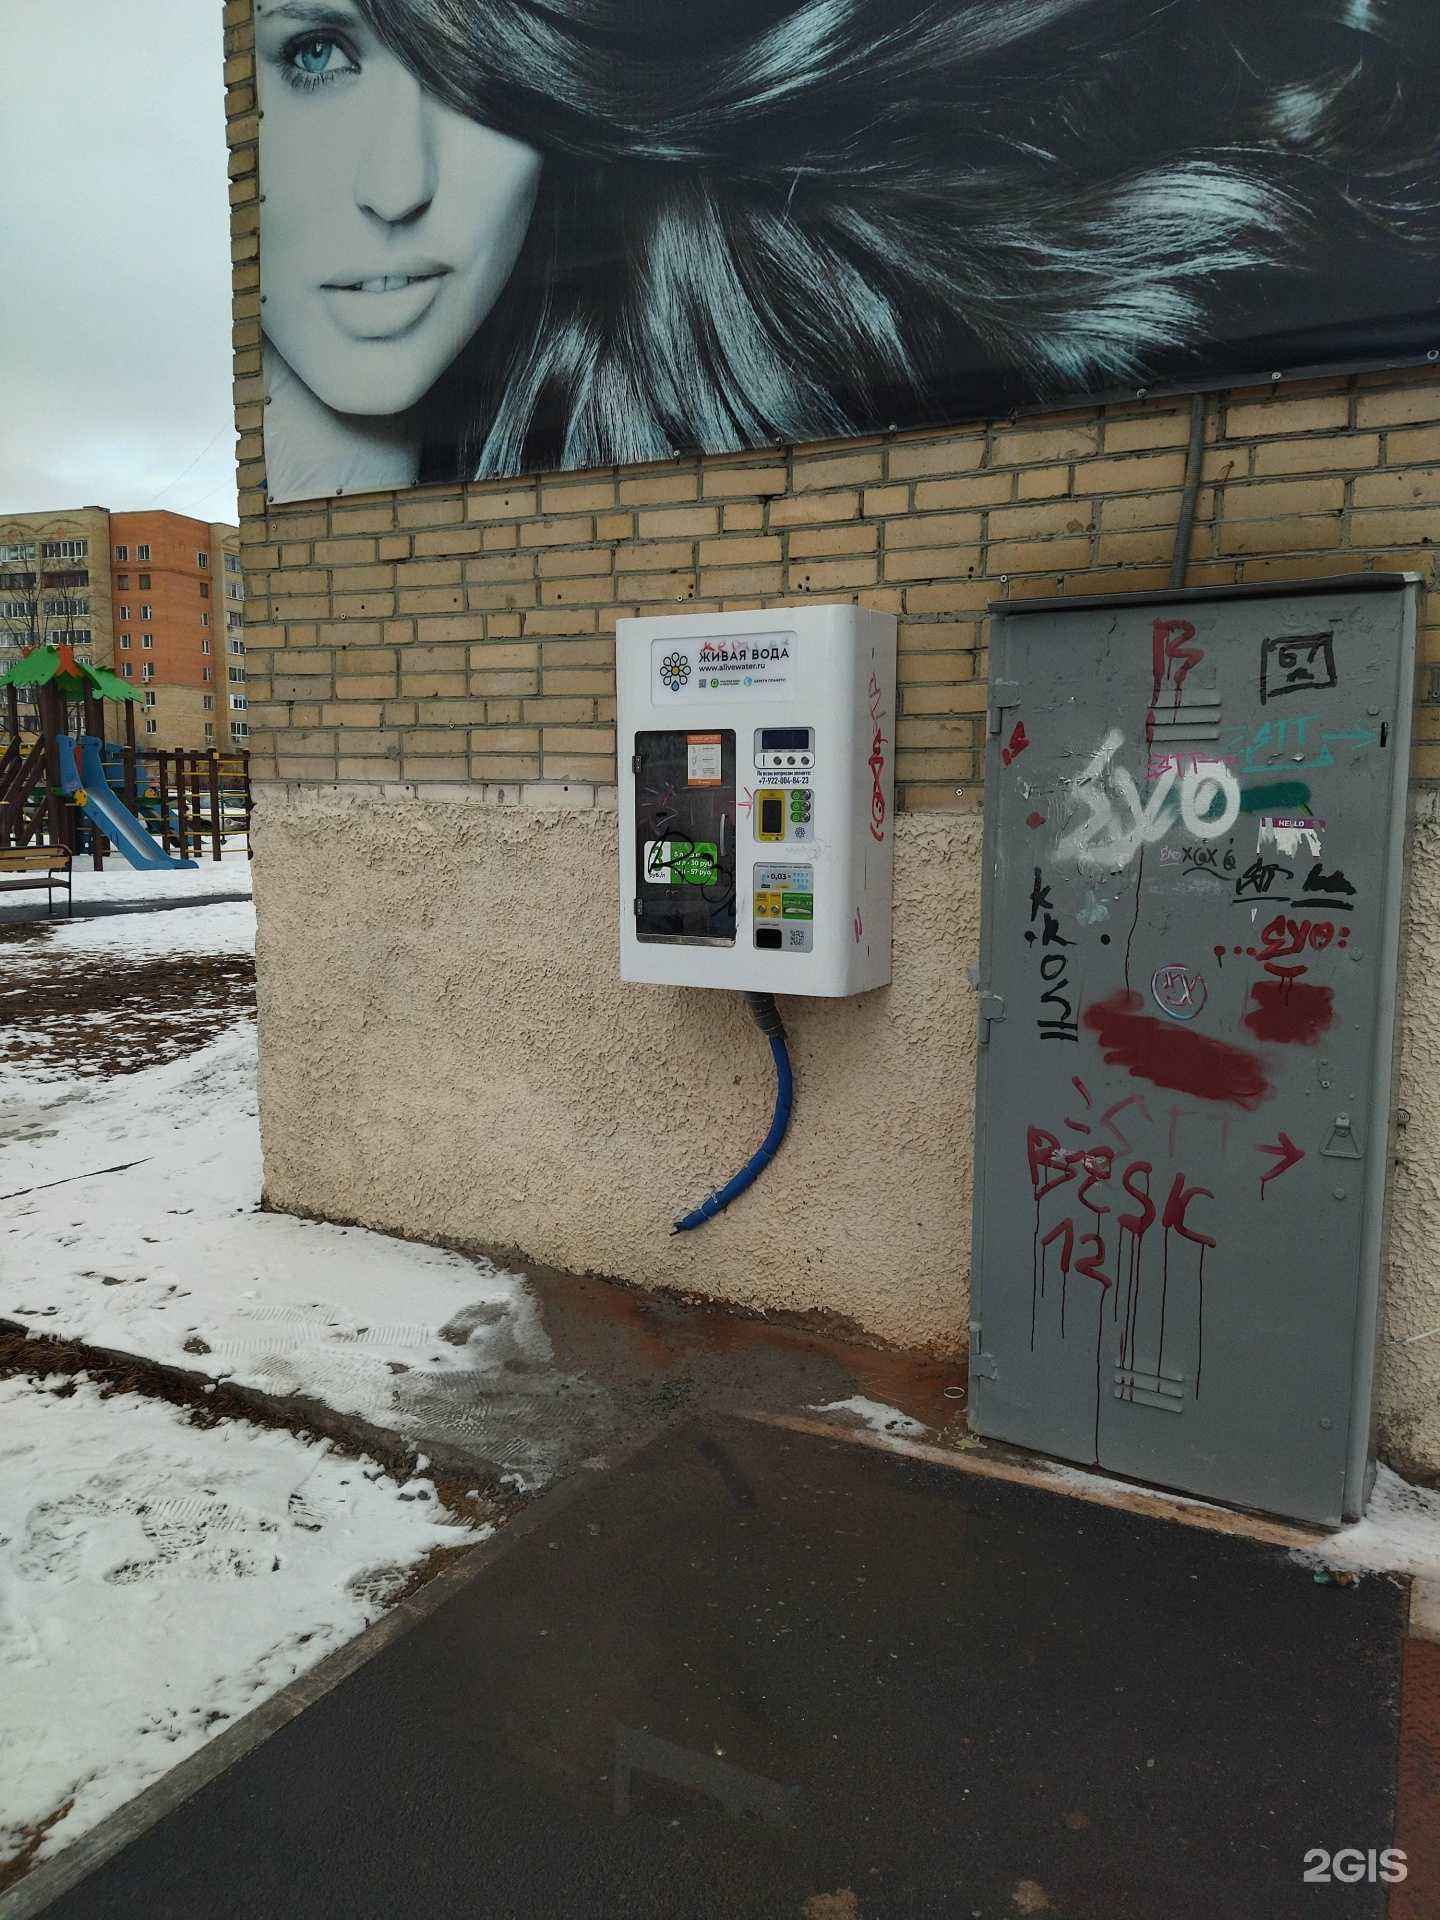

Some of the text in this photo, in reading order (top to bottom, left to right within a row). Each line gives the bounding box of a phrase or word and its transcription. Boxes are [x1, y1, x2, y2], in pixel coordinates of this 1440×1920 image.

[699, 647, 790, 662] ЖИВАЯ ВОДА
[699, 663, 766, 672] www.alivewater.ru
[1278, 820, 1305, 829] HELLO
